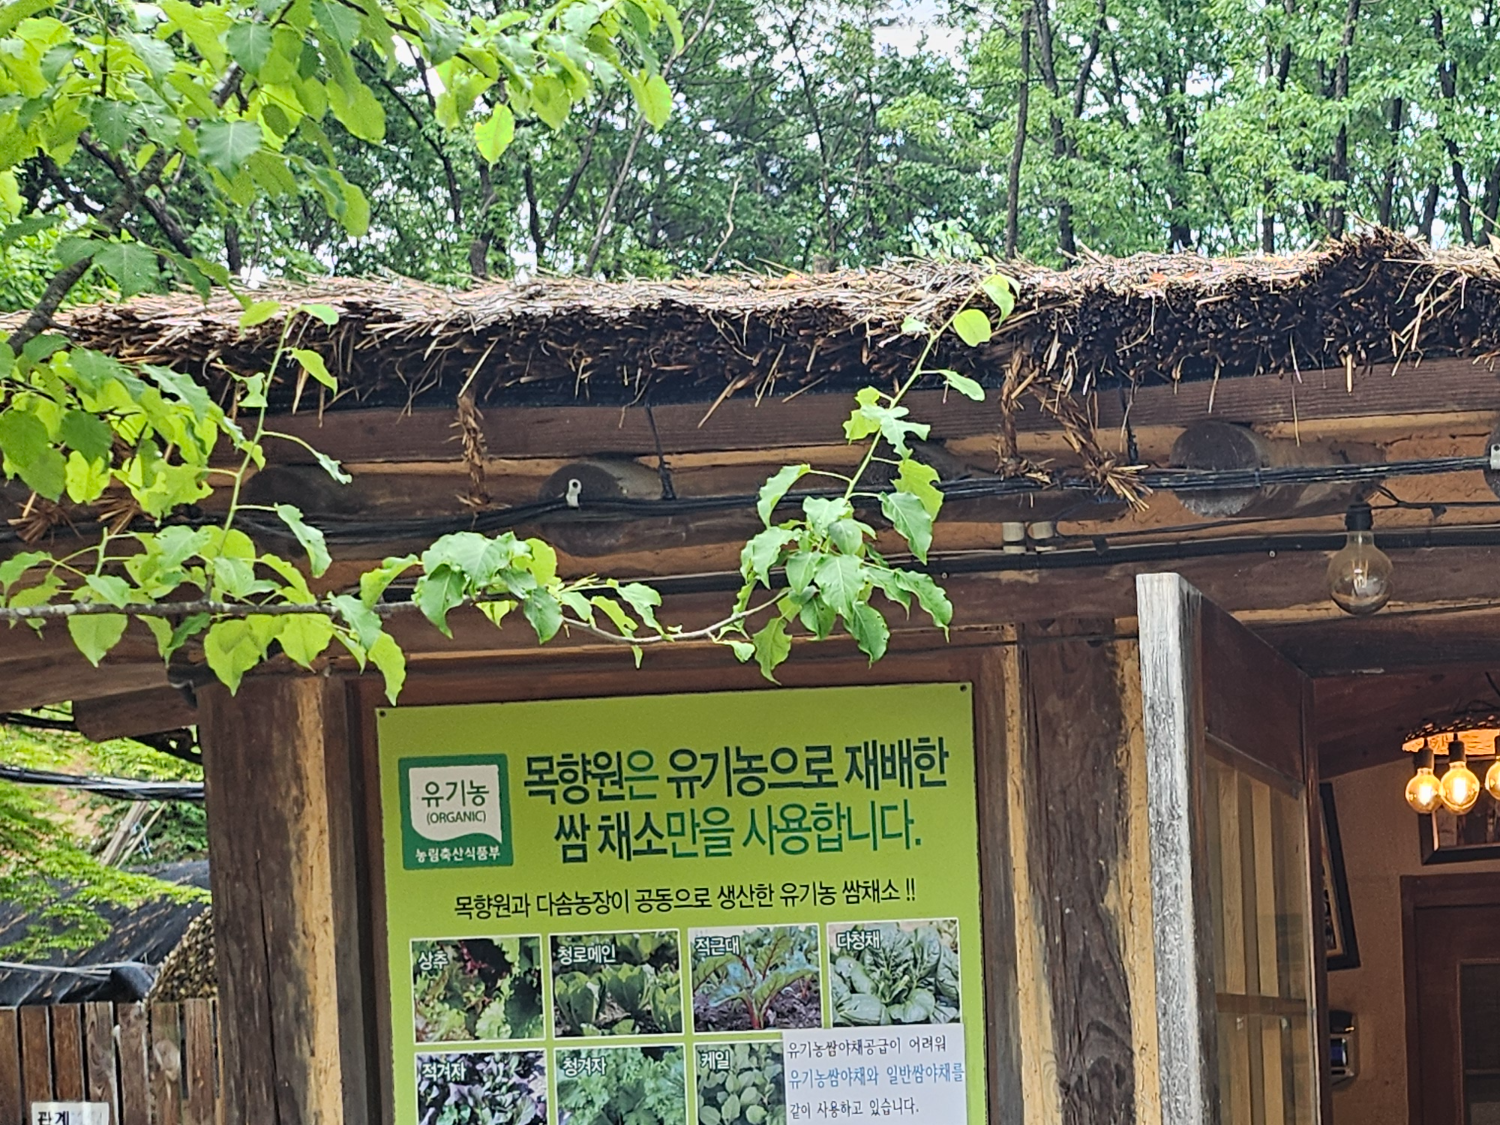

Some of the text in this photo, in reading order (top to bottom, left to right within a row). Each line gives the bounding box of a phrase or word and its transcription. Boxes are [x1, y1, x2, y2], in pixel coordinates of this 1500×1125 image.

[523, 736, 950, 805] 목향원은 유기농으로 재배한
[421, 779, 490, 808] 유기농
[426, 810, 487, 826] (ORGANIC)
[554, 799, 922, 864] 쌈 채소만을 사용합니다.
[415, 845, 501, 862] 농림축산식품부
[454, 892, 531, 920] 목향원과
[536, 888, 630, 917] 다솜농장이
[634, 887, 713, 913] 공동으로
[717, 882, 775, 910] 생산한
[779, 881, 838, 908] 유기농
[842, 879, 901, 905] 쌈채소
[694, 935, 741, 957] 적근대
[836, 930, 881, 951] 다청채
[417, 951, 449, 971] 상추
[557, 944, 616, 966] 청로메인
[787, 1034, 947, 1060] 유기농쌈야채공급이 어려워
[562, 1056, 607, 1077] 청겨자
[700, 1050, 731, 1071] 케일
[421, 1062, 467, 1082] 적겨자
[788, 1062, 965, 1090] 유기농쌈야채와 일반쌈야채를
[789, 1097, 920, 1120] 같이 사용하고 있습니다.
